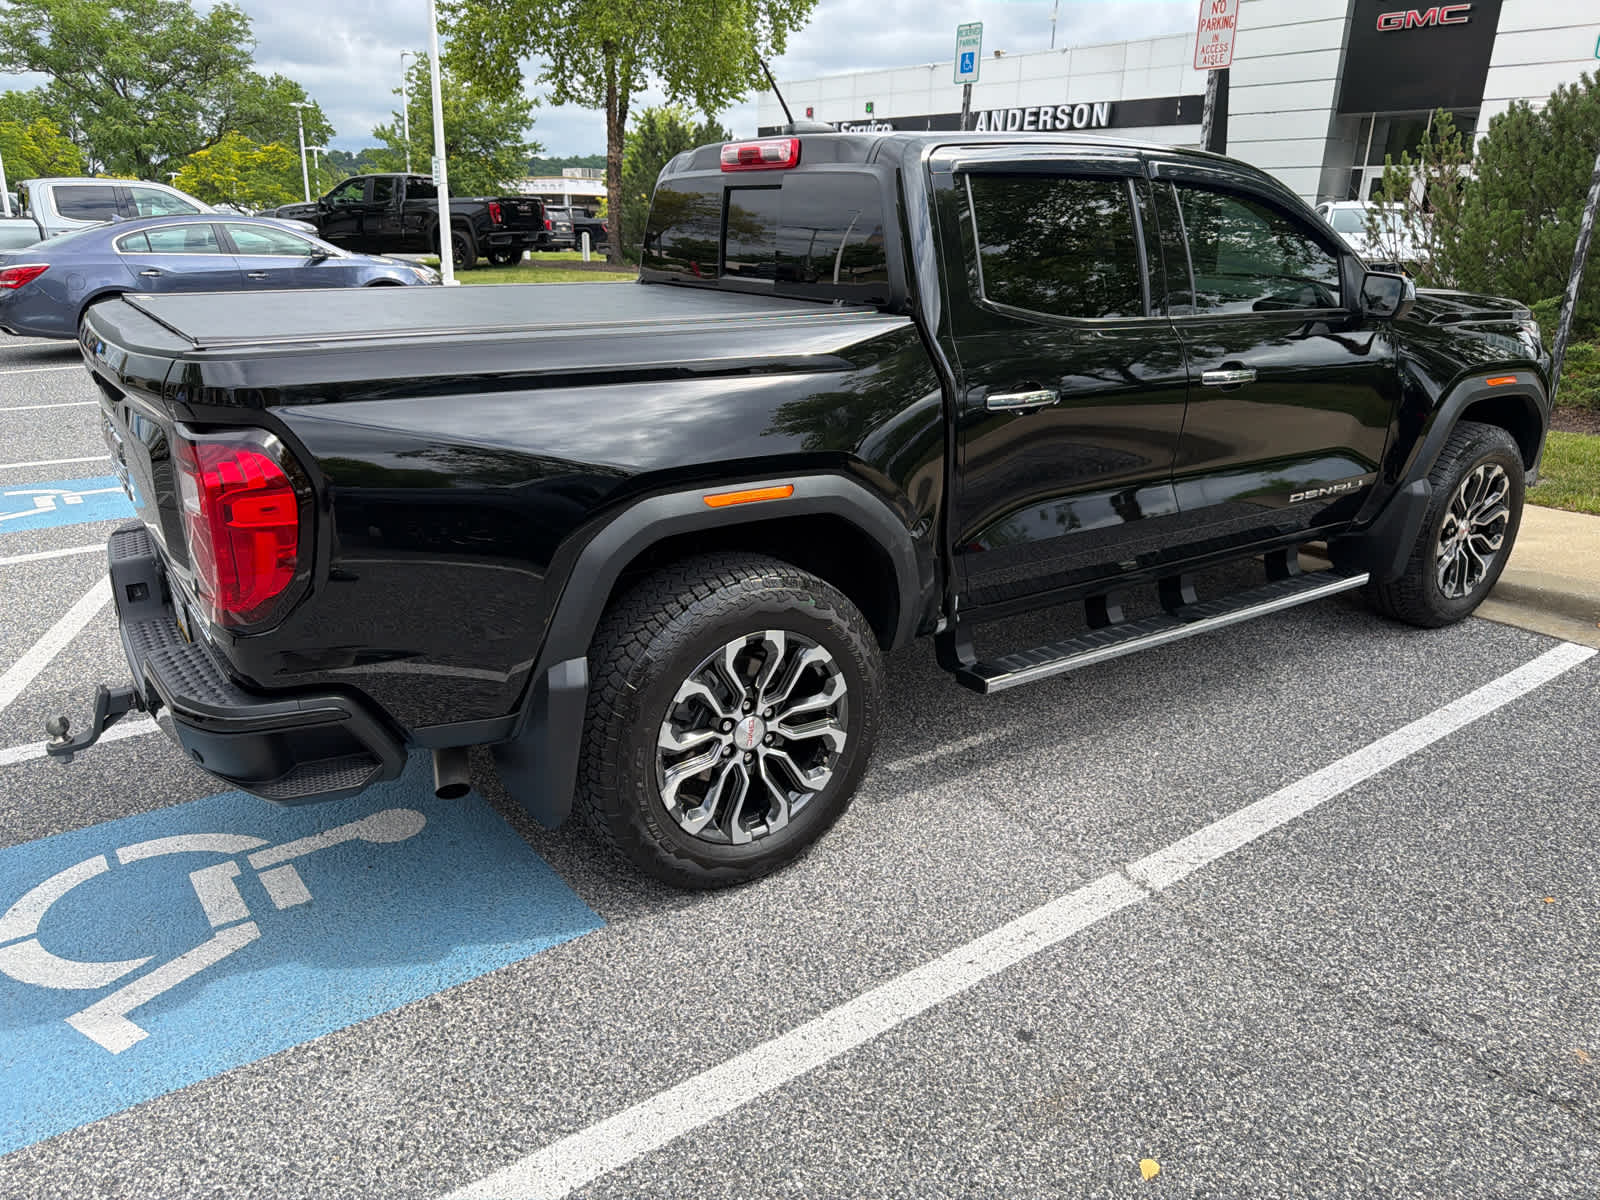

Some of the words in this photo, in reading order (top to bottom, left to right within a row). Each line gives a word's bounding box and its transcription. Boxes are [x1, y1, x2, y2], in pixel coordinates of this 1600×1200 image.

[1212, 0, 1227, 14] NO
[1200, 15, 1234, 32] PARKING
[1376, 3, 1472, 31] GMC
[1200, 42, 1228, 54] ACCESS
[1203, 54, 1224, 64] AISLE
[975, 102, 1112, 132] ANDERSON
[1289, 479, 1363, 503] DENALI
